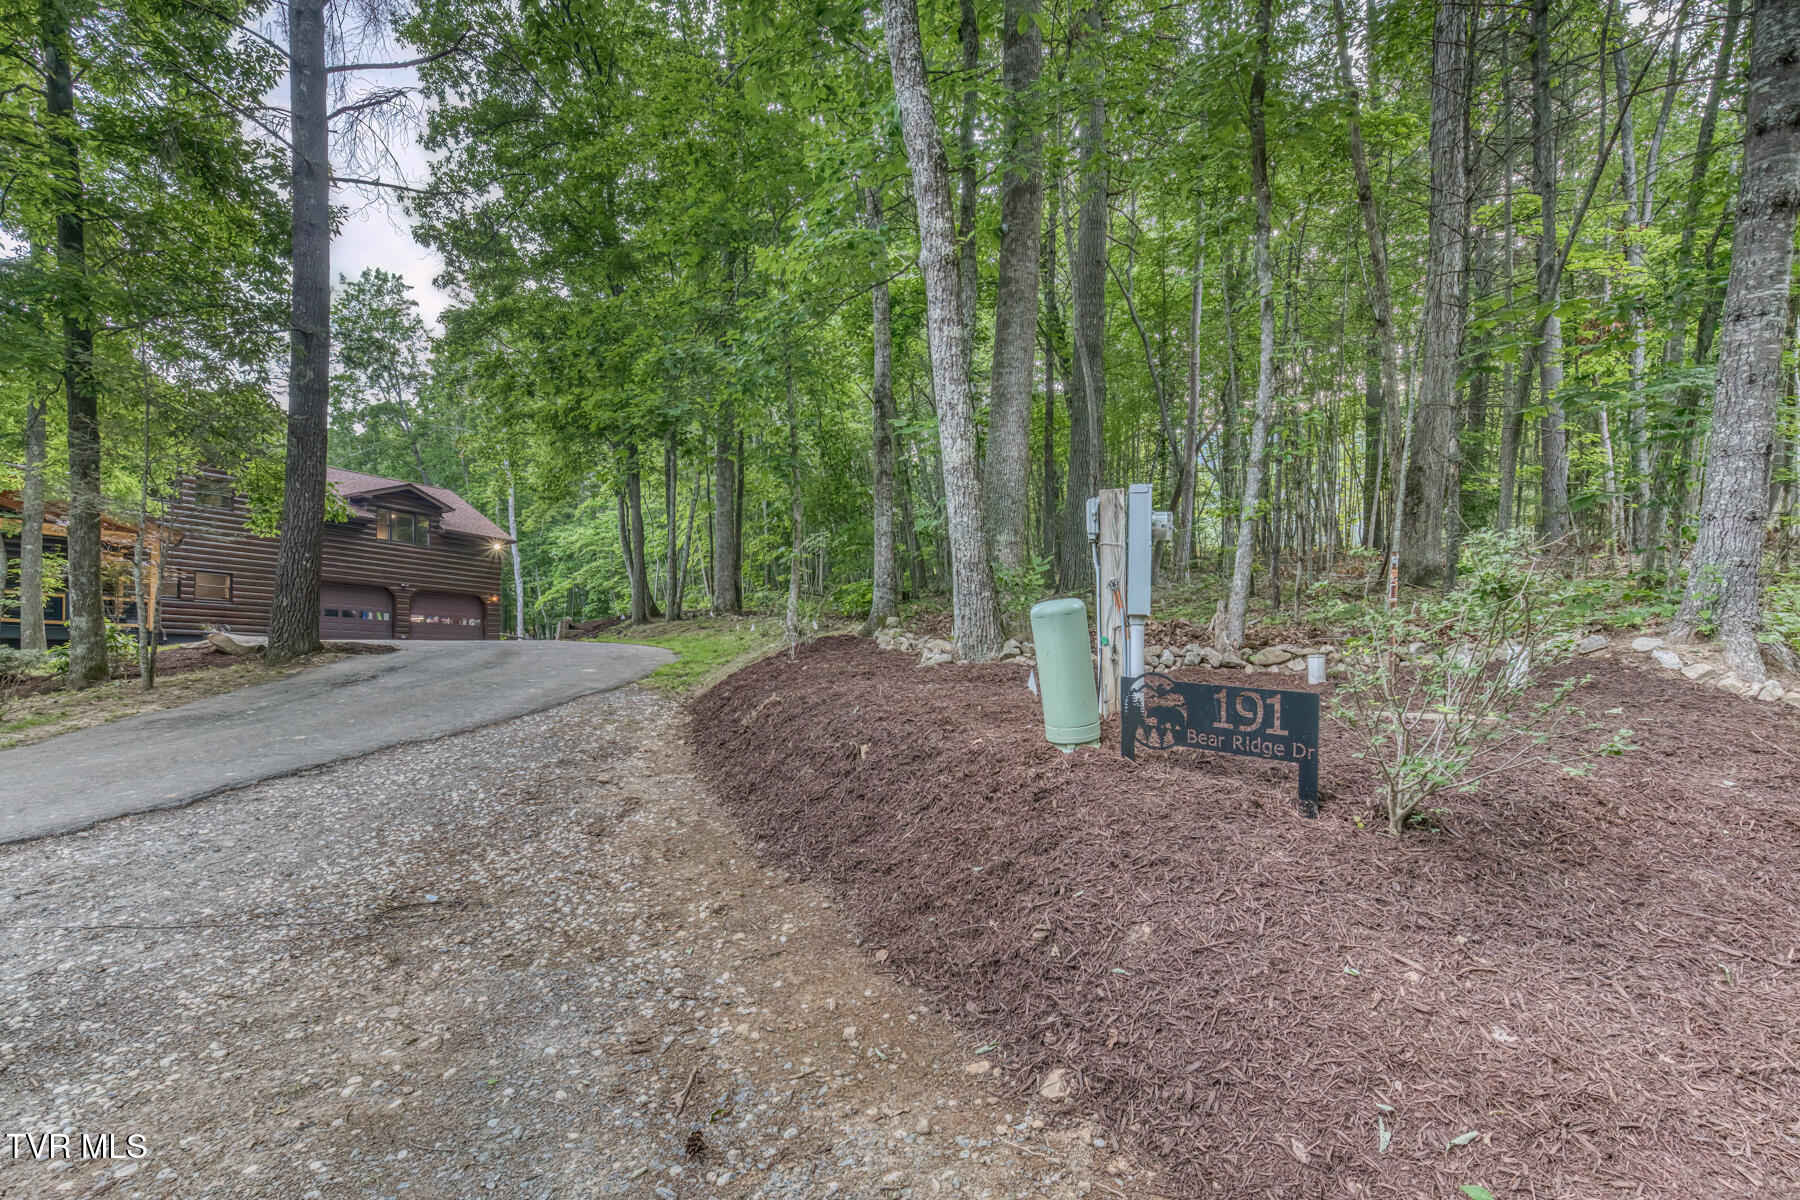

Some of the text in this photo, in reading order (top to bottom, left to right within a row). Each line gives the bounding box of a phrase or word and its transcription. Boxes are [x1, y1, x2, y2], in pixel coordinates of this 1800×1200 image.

[1213, 688, 1288, 736] 191
[1187, 729, 1316, 760] Bear Ridge Dr
